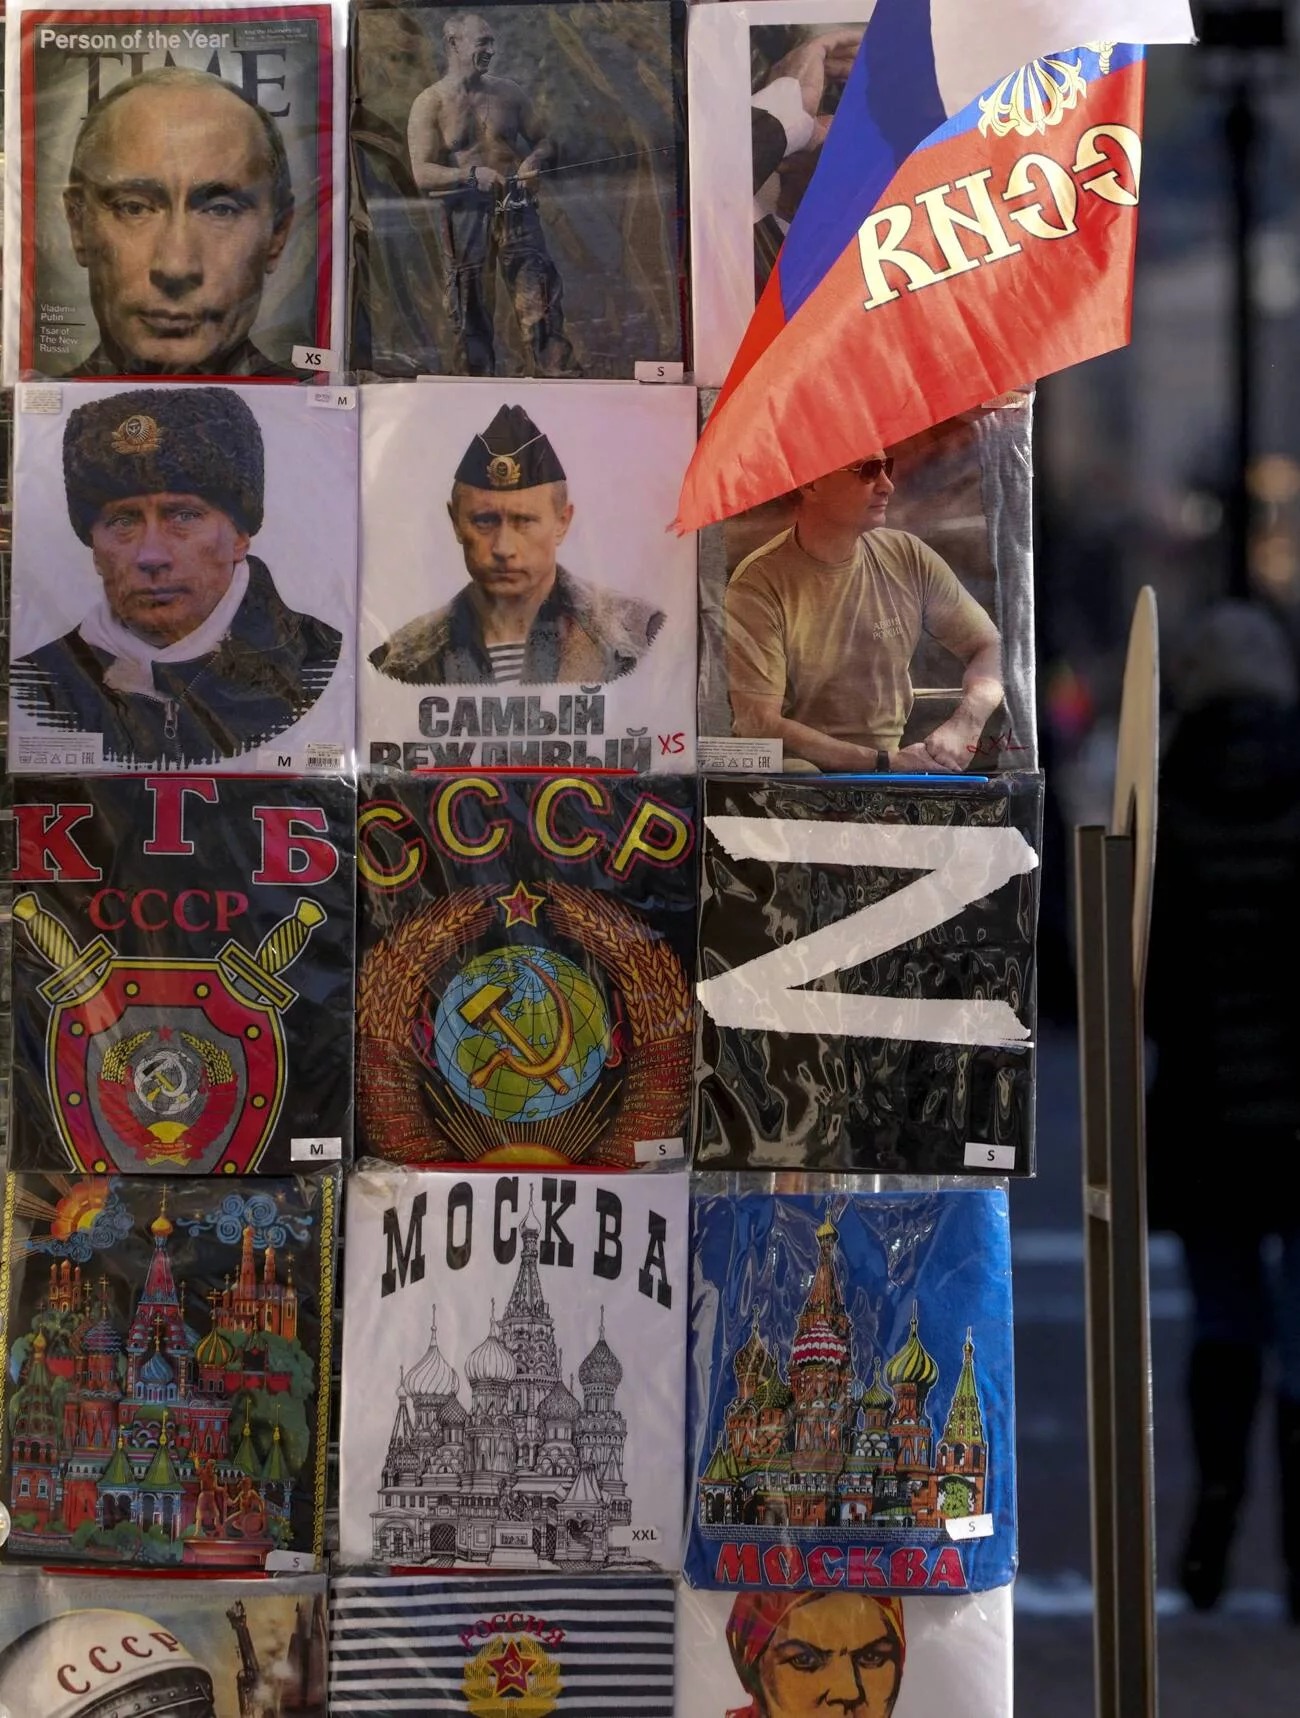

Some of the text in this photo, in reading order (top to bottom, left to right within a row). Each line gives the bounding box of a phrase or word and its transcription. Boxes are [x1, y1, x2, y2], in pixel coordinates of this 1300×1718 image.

[40, 29, 123, 50] Person
[124, 30, 141, 49] of
[148, 30, 181, 49] the
[182, 28, 230, 49] Year
[64, 48, 291, 120] TE
[40, 313, 64, 321] Putin
[40, 326, 60, 335] Tsar
[40, 335, 57, 344] The
[304, 352, 322, 366] XS
[656, 366, 665, 377] S
[337, 396, 348, 406] M
[418, 684, 605, 738] САМЫЙ
[658, 732, 686, 756] XS
[277, 755, 291, 768] M
[357, 775, 696, 893] СССР
[88, 888, 249, 932] СССР
[696, 815, 1039, 1048] Z
[309, 1142, 325, 1156] M
[658, 1144, 667, 1155] S
[987, 1149, 995, 1162] S
[380, 1176, 672, 1310] МОСКВА
[968, 1521, 976, 1533] S
[631, 1529, 657, 1541] XXL
[292, 1557, 300, 1568] S
[715, 1542, 969, 1590] МОСКВА
[458, 1612, 566, 1651] РОССИЯ
[57, 1631, 180, 1695] СССР
